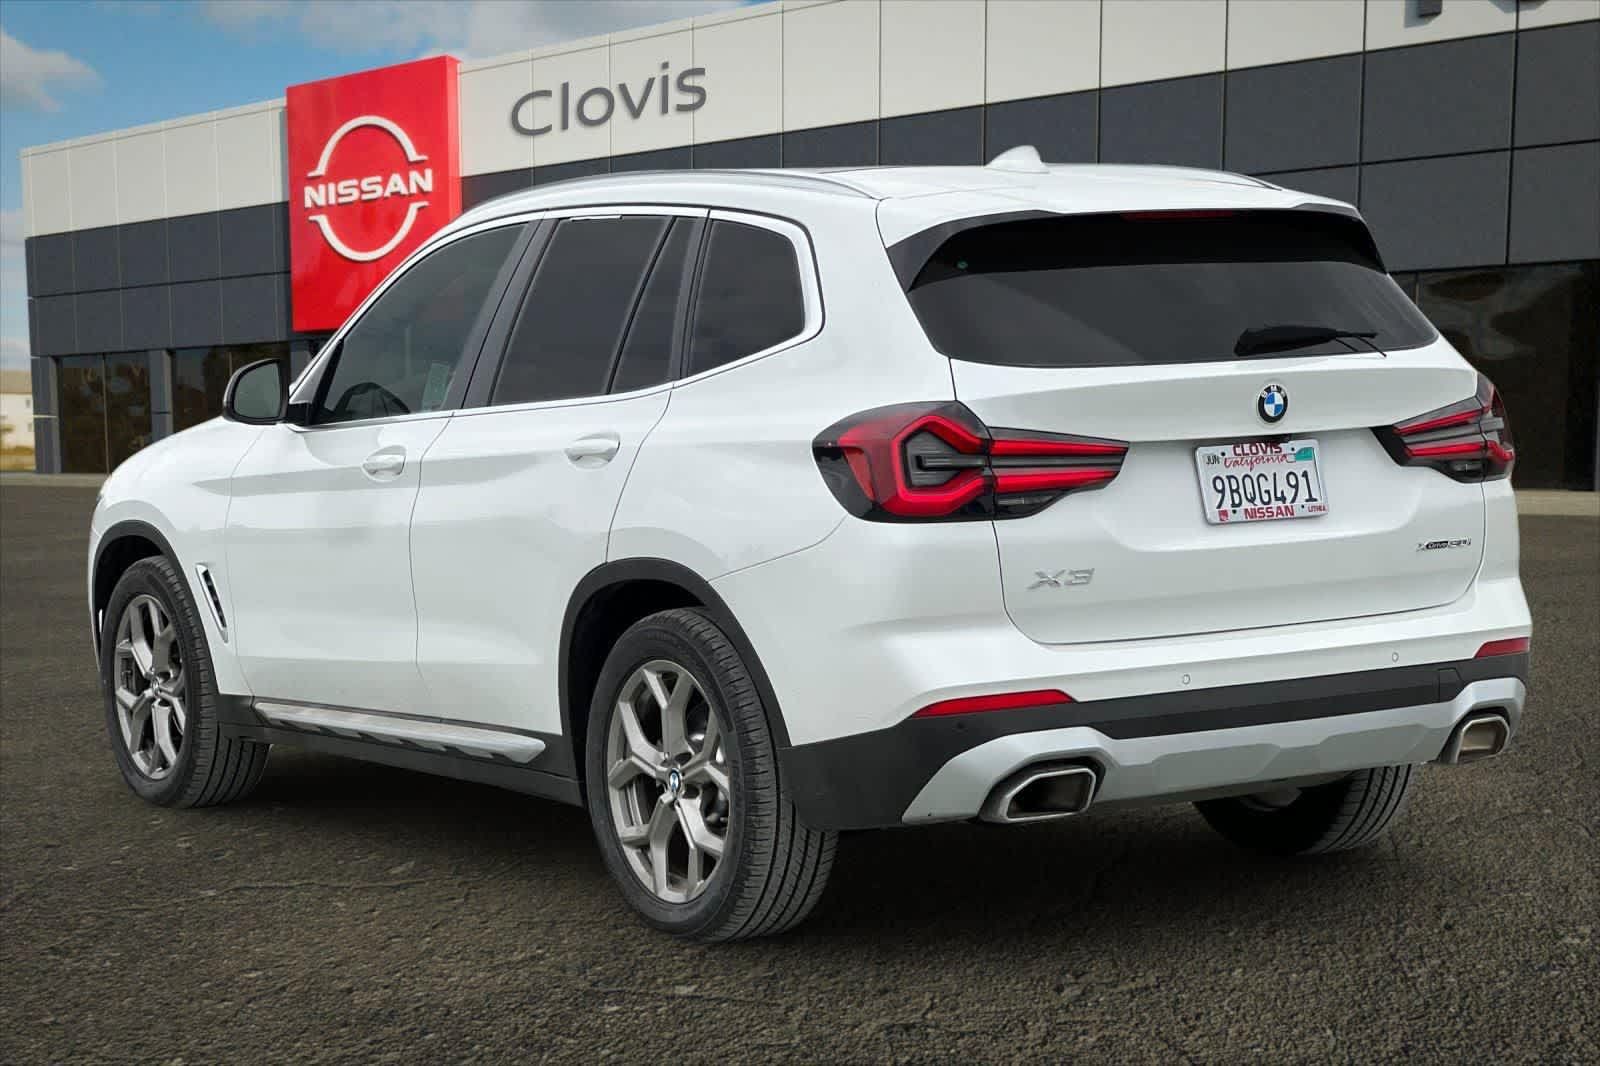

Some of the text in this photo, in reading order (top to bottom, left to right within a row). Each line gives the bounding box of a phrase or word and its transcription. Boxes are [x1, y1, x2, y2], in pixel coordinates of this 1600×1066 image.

[511, 62, 706, 137] Clovis
[304, 168, 433, 209] NISSAN
[1232, 442, 1283, 457] CLOVIS
[1224, 453, 1288, 472] California
[1212, 470, 1318, 510] 9BQG491
[1244, 505, 1295, 519] NISSAN
[1025, 567, 1095, 590] X3
